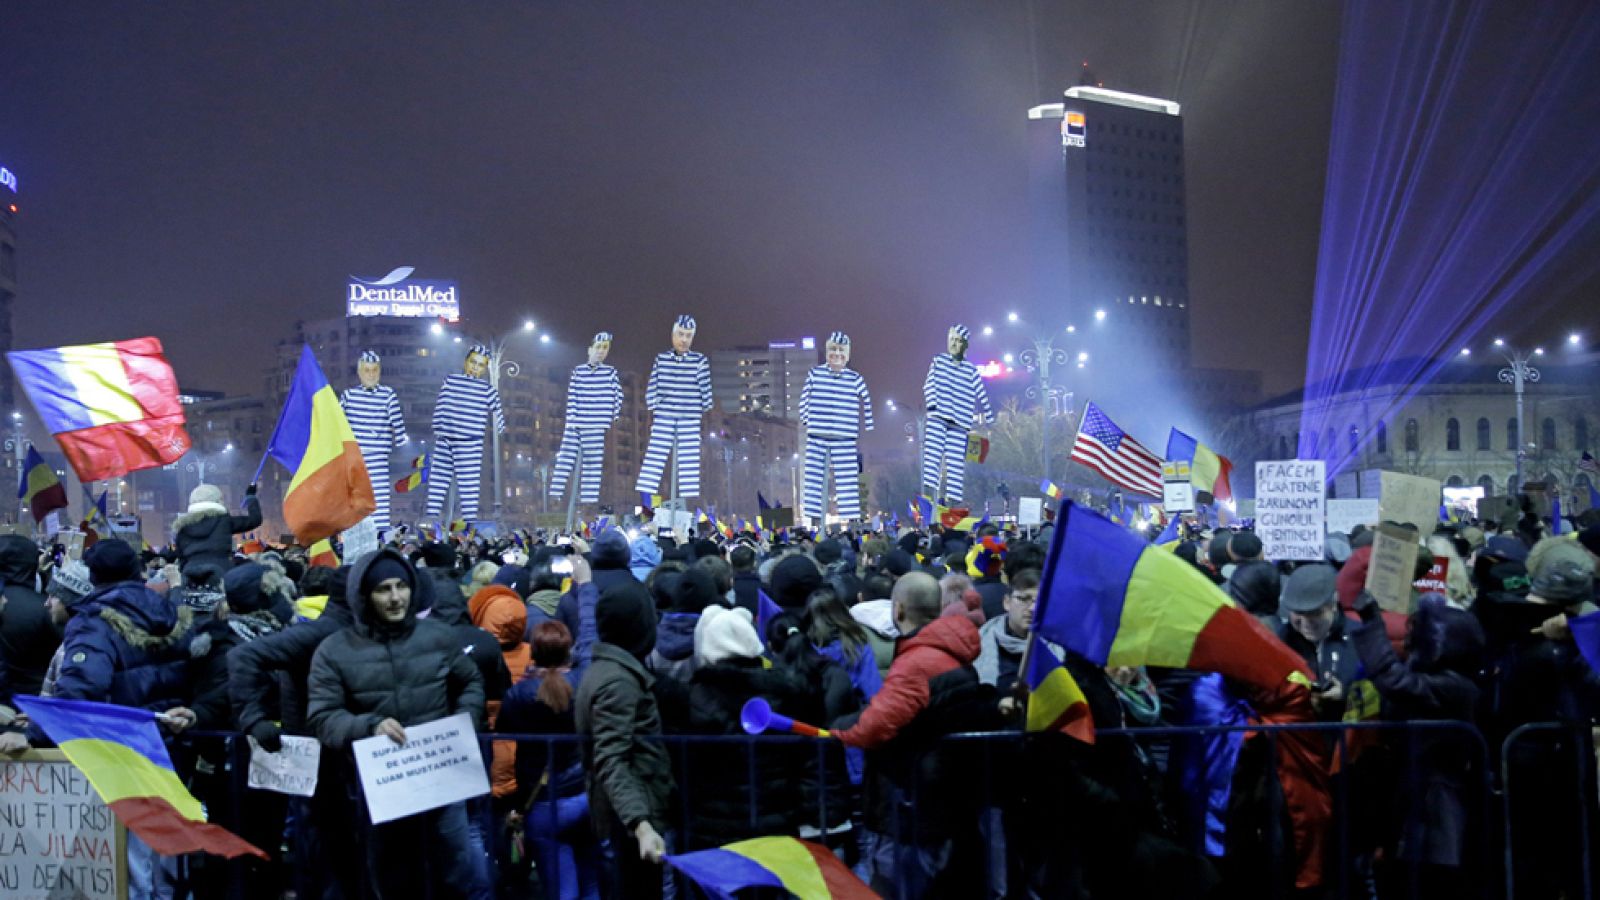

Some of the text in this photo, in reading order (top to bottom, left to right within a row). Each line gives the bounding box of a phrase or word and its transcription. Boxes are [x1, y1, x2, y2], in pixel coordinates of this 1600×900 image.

[349, 283, 456, 303] DentalMed
[386, 760, 399, 769] DE
[376, 772, 403, 785] LUAM
[34, 801, 56, 829] FI
[0, 831, 112, 864] LA JILAVA
